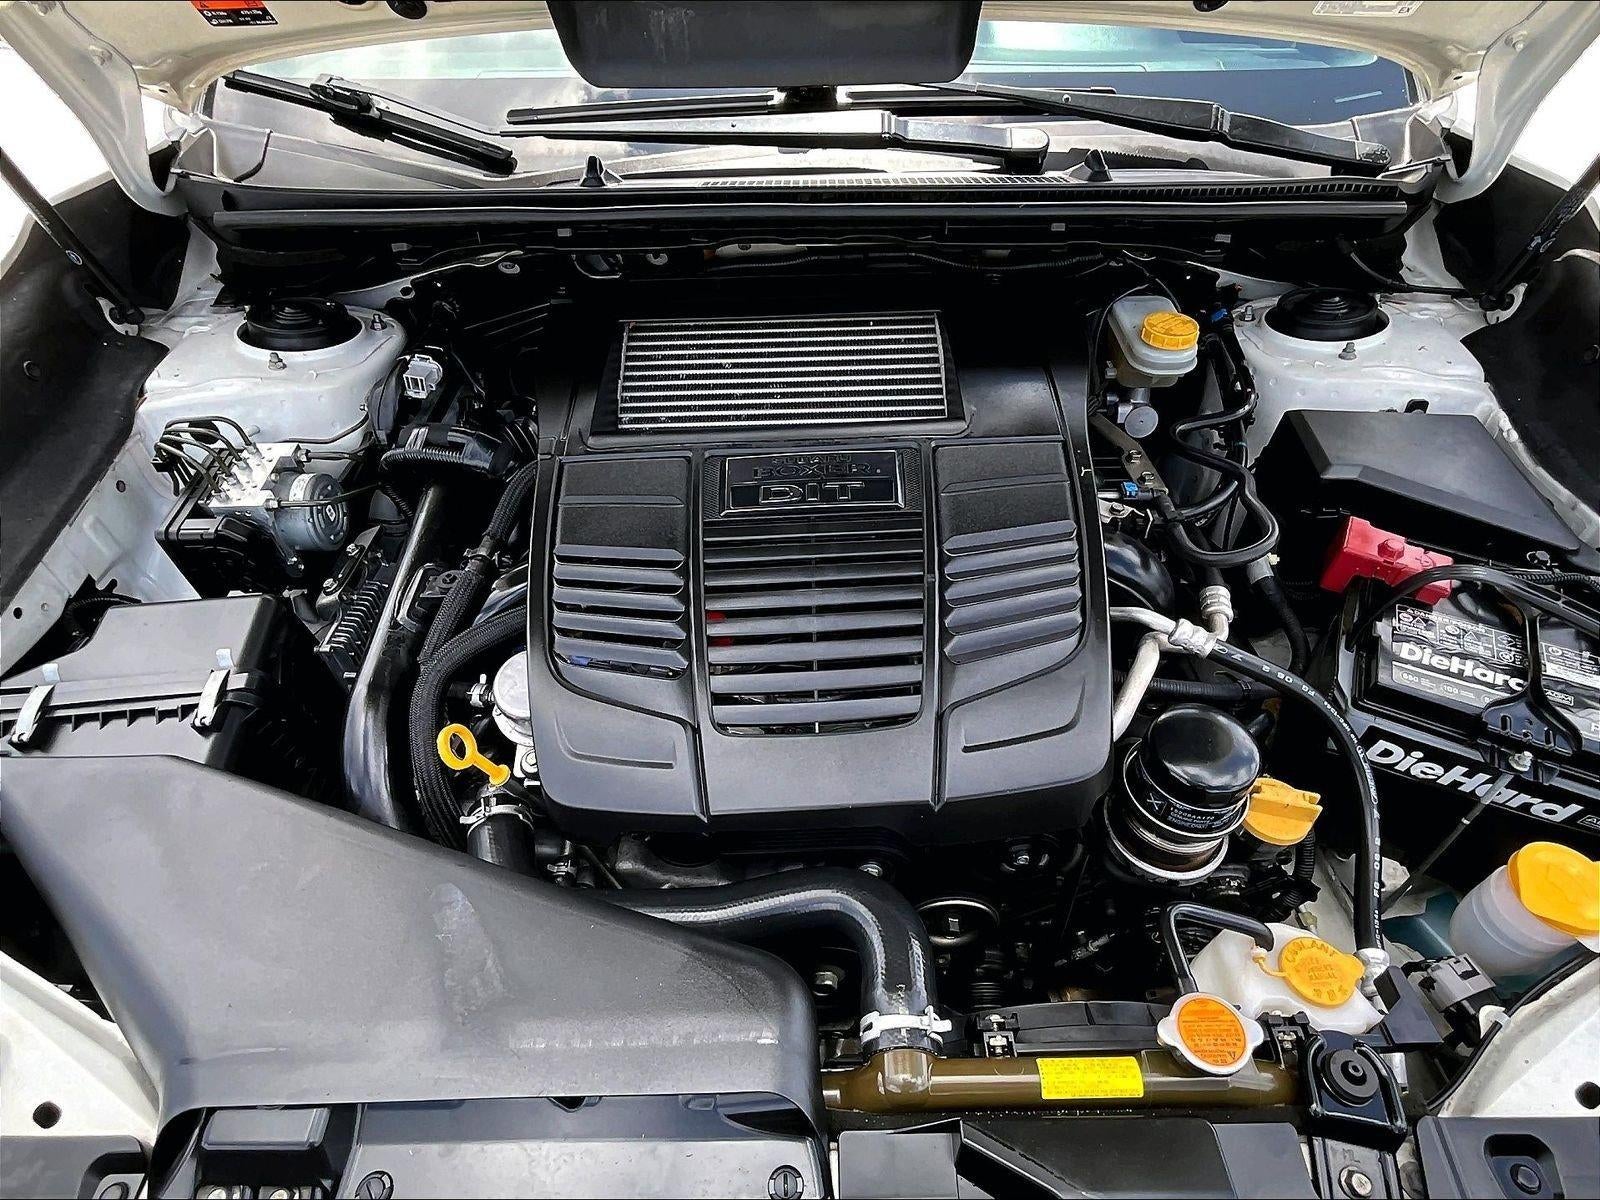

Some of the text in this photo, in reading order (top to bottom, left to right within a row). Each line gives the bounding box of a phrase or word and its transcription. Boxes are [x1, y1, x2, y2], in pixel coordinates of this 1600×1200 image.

[753, 463, 871, 479] BOXER
[759, 481, 866, 504] DIT
[1365, 739, 1584, 822] DieHard
